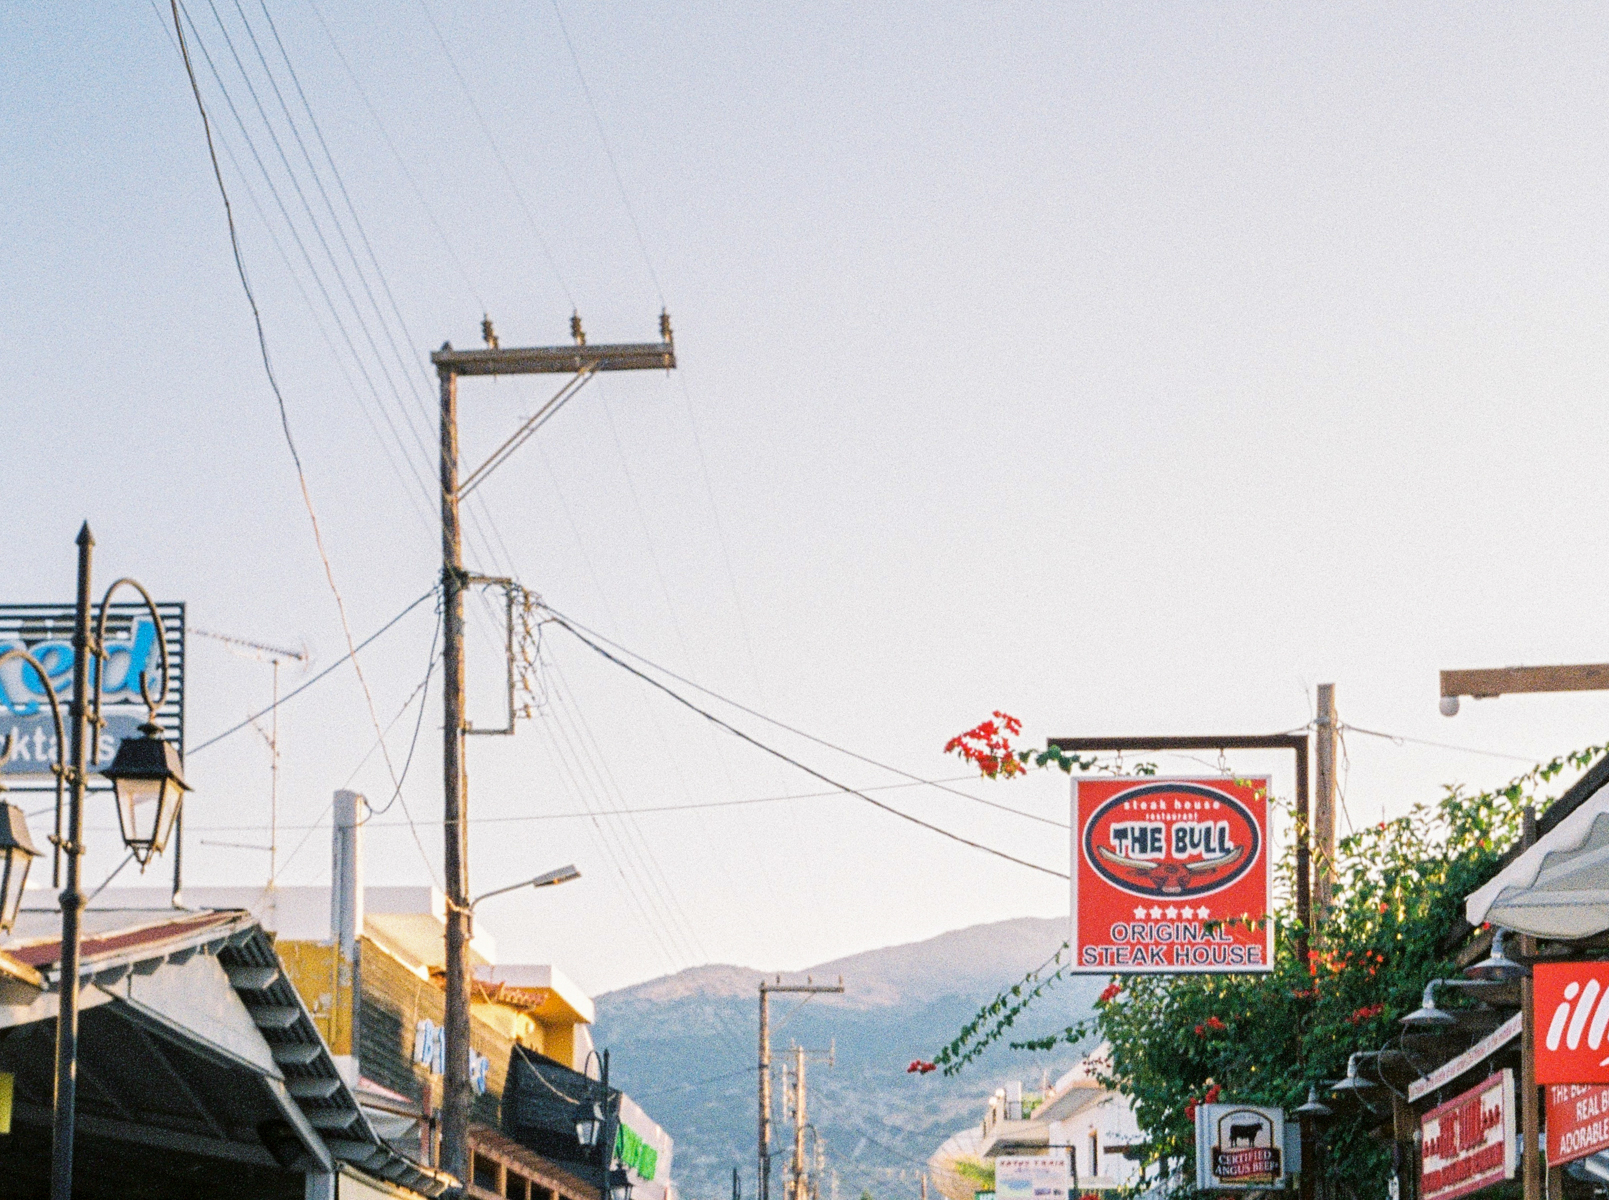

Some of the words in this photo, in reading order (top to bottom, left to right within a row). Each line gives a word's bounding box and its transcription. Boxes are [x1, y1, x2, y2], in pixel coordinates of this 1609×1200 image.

[1124, 799, 1166, 811] steak
[1174, 798, 1220, 810] house
[1145, 811, 1198, 821] restaurant
[1112, 824, 1164, 857] THE
[1173, 823, 1233, 856] BULL
[1111, 921, 1232, 942] ORIGINAL
[1083, 945, 1166, 965] STEAK
[1174, 945, 1262, 965] HOUSE
[1546, 979, 1609, 1051] ill
[1576, 1094, 1600, 1122] REAL
[1218, 1149, 1272, 1165] CERTIFIED
[1214, 1162, 1251, 1177] ANGUS
